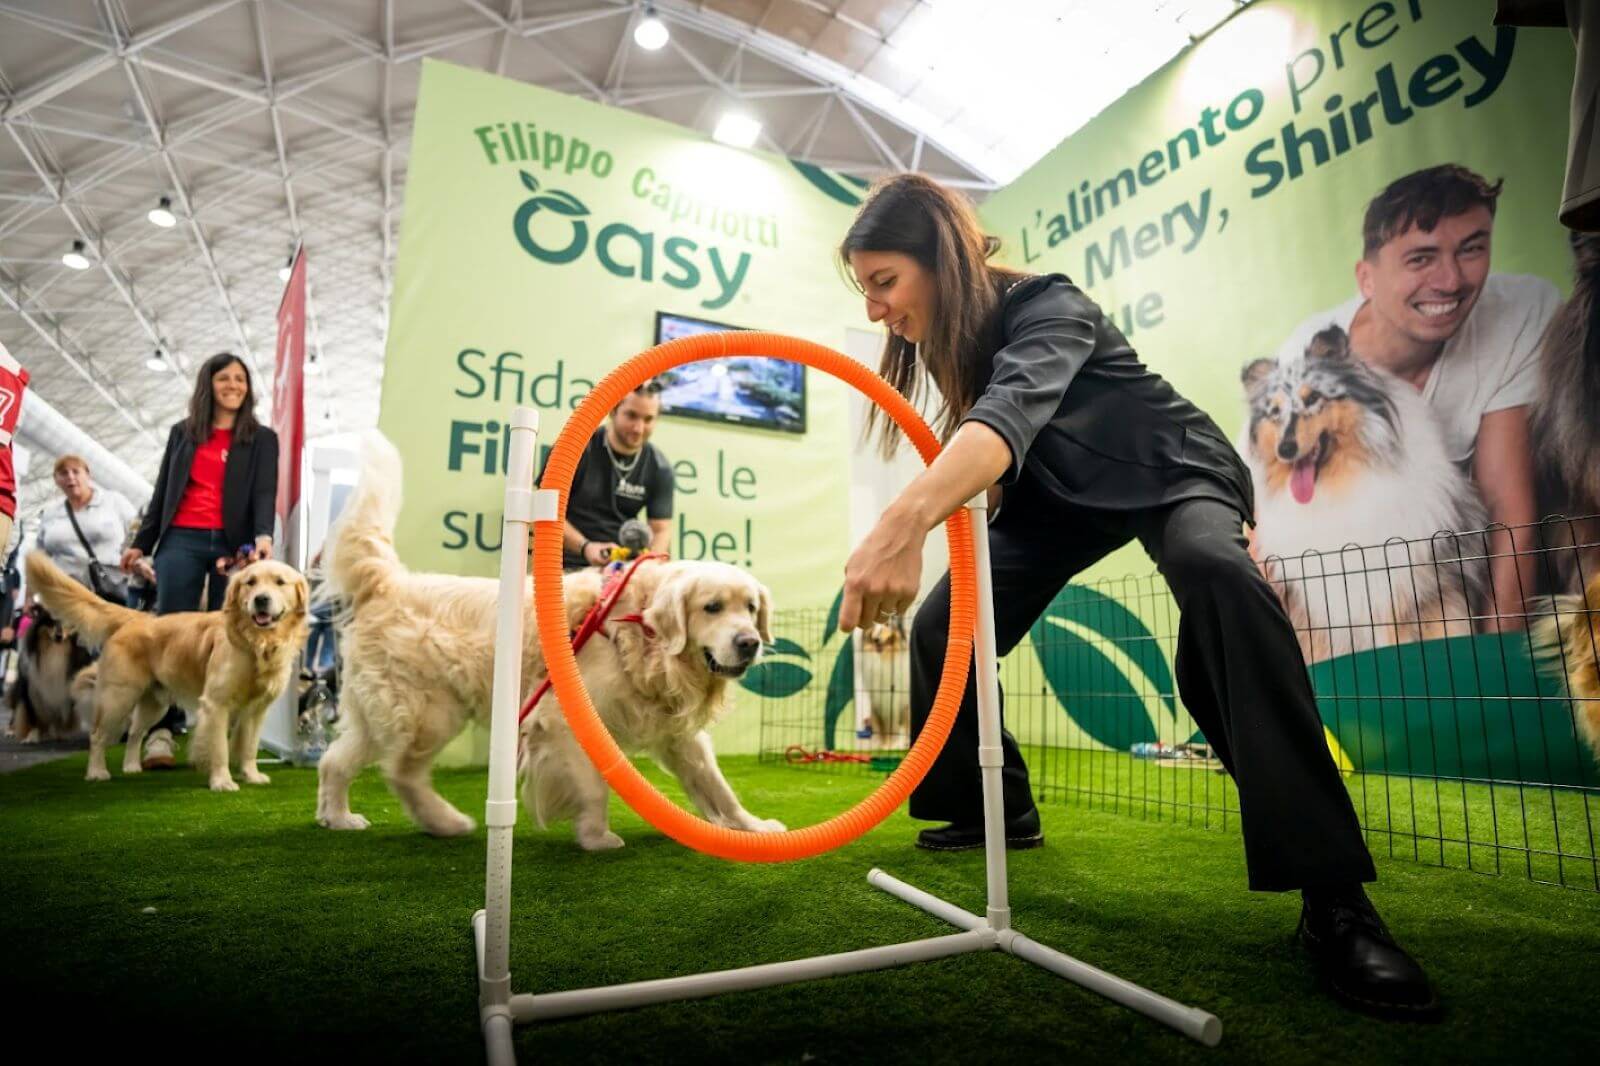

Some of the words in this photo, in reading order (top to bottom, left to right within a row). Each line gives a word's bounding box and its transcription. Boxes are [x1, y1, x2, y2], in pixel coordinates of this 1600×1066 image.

[474, 121, 613, 179] Filippo
[631, 166, 780, 248] Capriotti
[1084, 188, 1230, 289] Mery,
[1243, 26, 1517, 198] Shirley
[513, 189, 752, 309] Oasy
[718, 449, 757, 499] le
